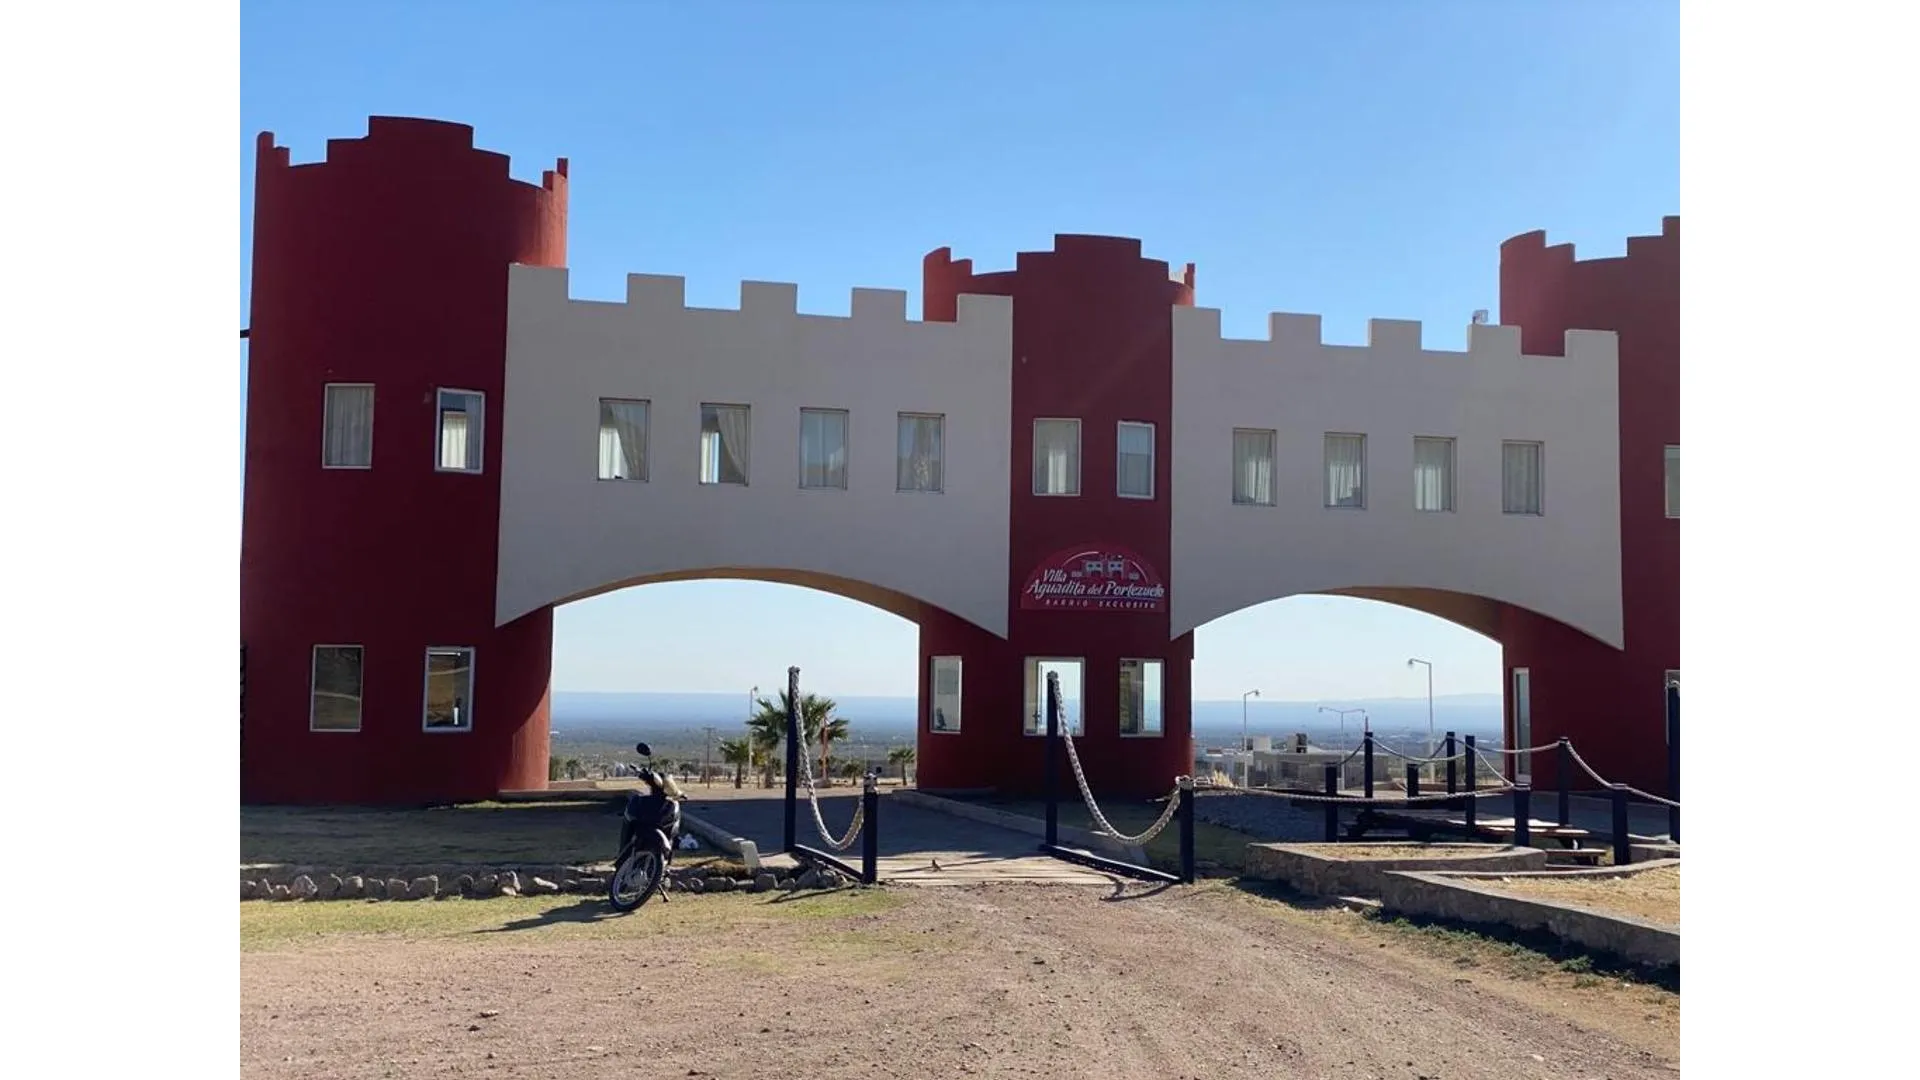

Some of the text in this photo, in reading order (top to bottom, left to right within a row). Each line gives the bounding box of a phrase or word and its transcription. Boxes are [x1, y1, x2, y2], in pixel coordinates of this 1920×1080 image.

[1043, 569, 1067, 582] Villa
[1026, 579, 1165, 600] Aguadita del Portezuelo
